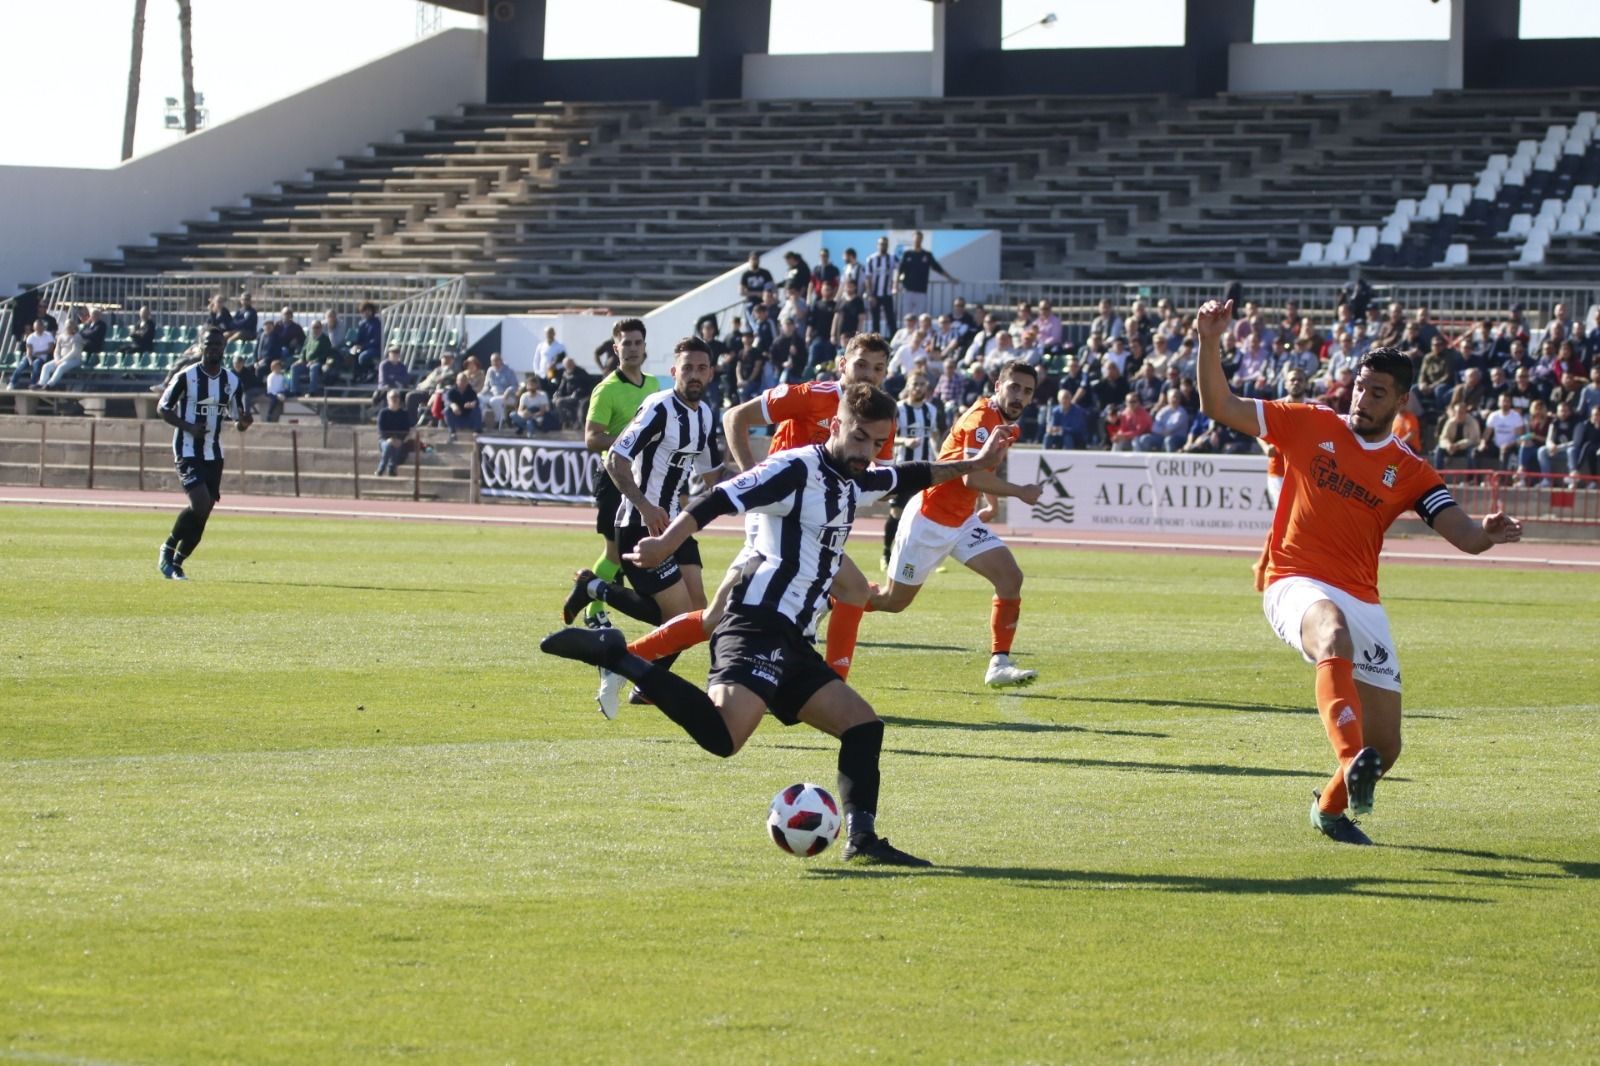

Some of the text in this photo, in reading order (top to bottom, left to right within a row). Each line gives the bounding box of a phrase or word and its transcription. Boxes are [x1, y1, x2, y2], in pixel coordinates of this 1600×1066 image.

[1156, 460, 1214, 477] GRUPO
[1095, 483, 1273, 511] ALCAIDESA
[1317, 479, 1350, 498] group
[1319, 467, 1383, 509] Talasur
[1238, 520, 1272, 530] EVENTO
